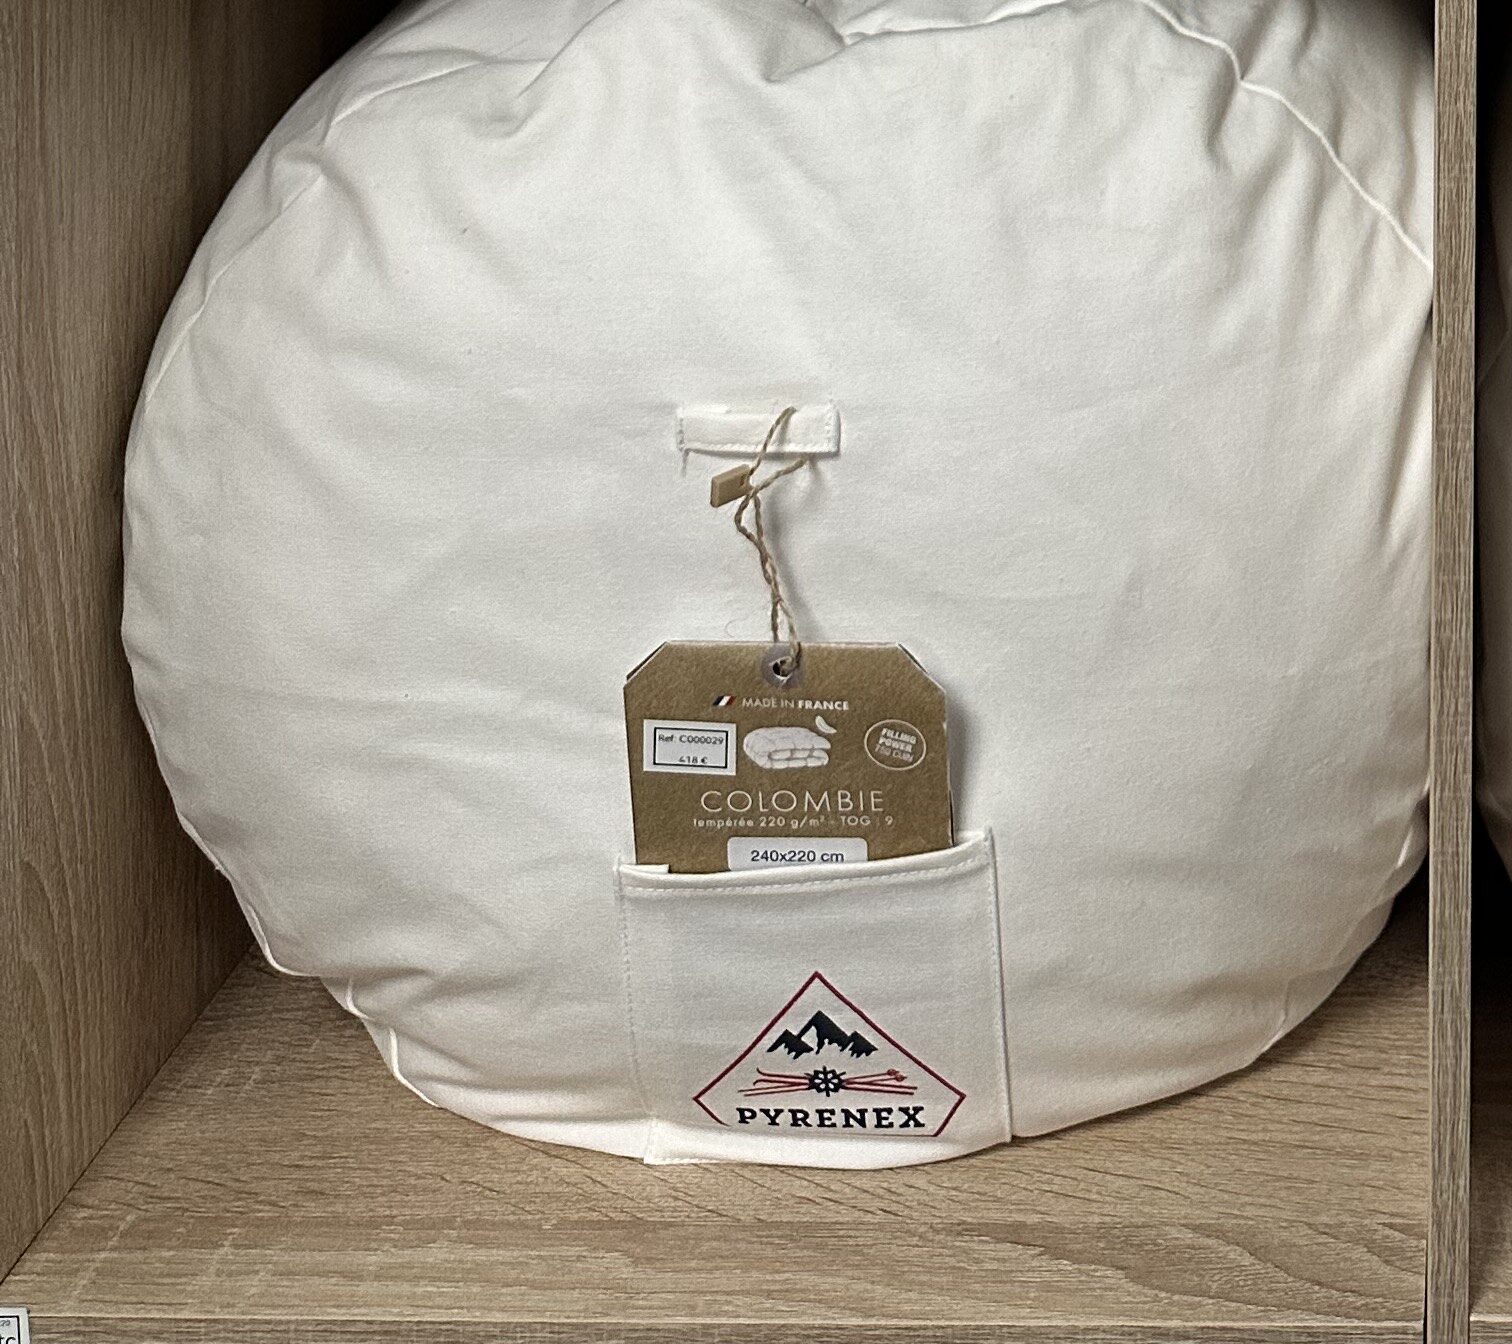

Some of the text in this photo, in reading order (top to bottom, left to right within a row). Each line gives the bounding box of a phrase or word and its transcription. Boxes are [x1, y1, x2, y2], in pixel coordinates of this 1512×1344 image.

[742, 697, 849, 711] MADE IN FRANCE
[701, 756, 708, 764] €
[701, 790, 884, 813] COLOMBIE
[693, 816, 754, 829] tempérée
[759, 816, 786, 827] 220
[840, 815, 871, 827] TOG
[885, 815, 893, 825] 9
[751, 850, 844, 863] 240x220 cm
[736, 1106, 925, 1128] PYRENEX
